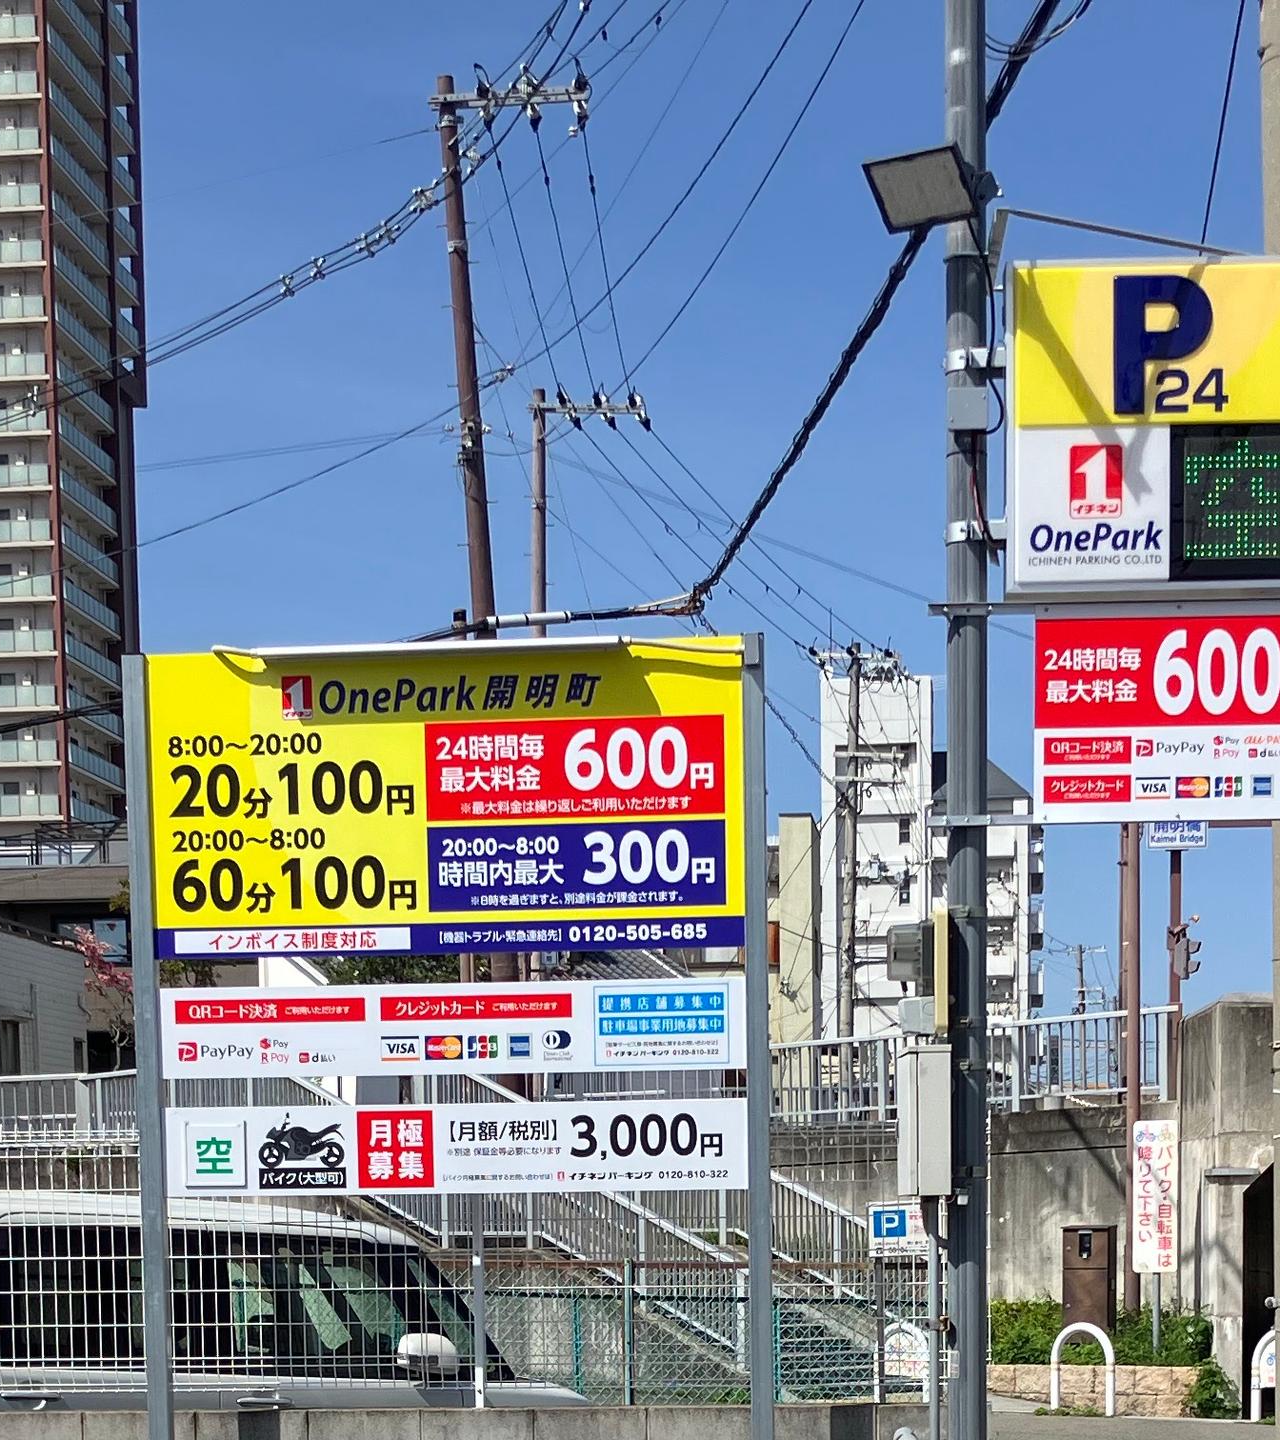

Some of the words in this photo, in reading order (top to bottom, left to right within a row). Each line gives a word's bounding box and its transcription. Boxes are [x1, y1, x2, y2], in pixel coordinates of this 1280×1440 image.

[1114, 275, 1213, 414] P
[1155, 368, 1229, 413] 24
[1072, 503, 1120, 515] イチネン
[1029, 520, 1162, 552] OnePark
[1028, 556, 1072, 567] ICHINEN
[1075, 555, 1121, 566] PARKING
[1043, 647, 1142, 672] 24時間毎
[319, 675, 476, 715] OnePark
[482, 673, 602, 711] 開明町
[1045, 678, 1138, 704] 最大料金
[435, 733, 545, 762] 24時間毎
[563, 725, 715, 792] 600円
[1050, 740, 1125, 754] QRコード決済
[1156, 741, 1205, 756] PayPay
[439, 764, 541, 793] 最大料金
[1050, 778, 1125, 793] クレジットカード
[1141, 783, 1167, 793] VISA
[1180, 834, 1204, 845] Bridge
[582, 828, 716, 885] 300円
[438, 858, 565, 888] 時間内最大
[208, 930, 378, 951] インボイス制度対応
[568, 922, 708, 943] 0120-505-685
[188, 1003, 278, 1020] QRコード決済
[395, 1000, 486, 1017] クレジットカード
[200, 1044, 254, 1060] PayPay
[385, 1043, 416, 1054] VISA
[369, 1118, 424, 1149] 月極
[569, 1112, 723, 1161] 3,000円
[195, 1136, 234, 1175] 空
[367, 1151, 425, 1180] 募集
[658, 1169, 729, 1179] 0120-810-322
[1137, 1146, 1153, 1243] 降りて下さい
[880, 1212, 900, 1237] P
